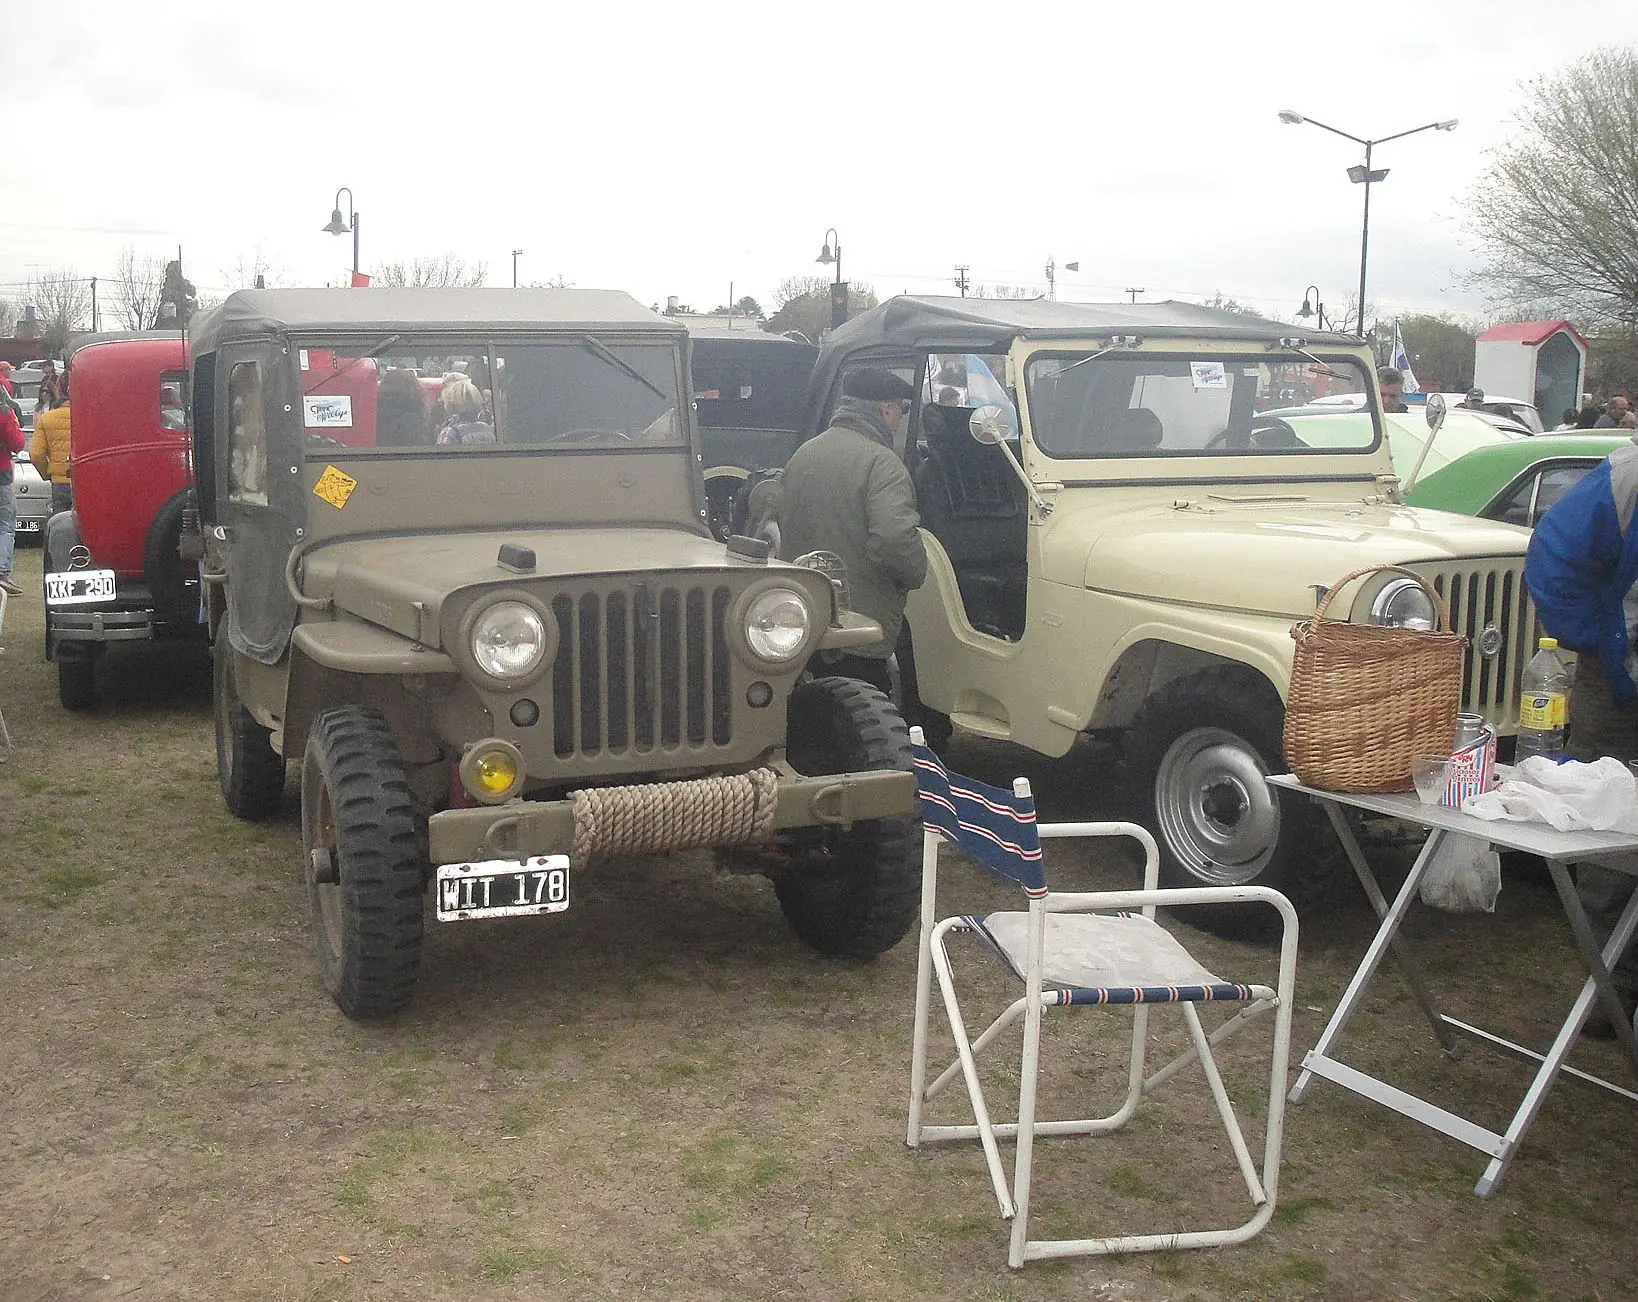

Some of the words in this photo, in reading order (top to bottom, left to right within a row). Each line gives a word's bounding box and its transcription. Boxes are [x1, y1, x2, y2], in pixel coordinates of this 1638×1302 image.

[49, 580, 77, 598] XKF
[85, 578, 113, 596] 290
[443, 876, 495, 910] WIT
[512, 870, 564, 905] 178
